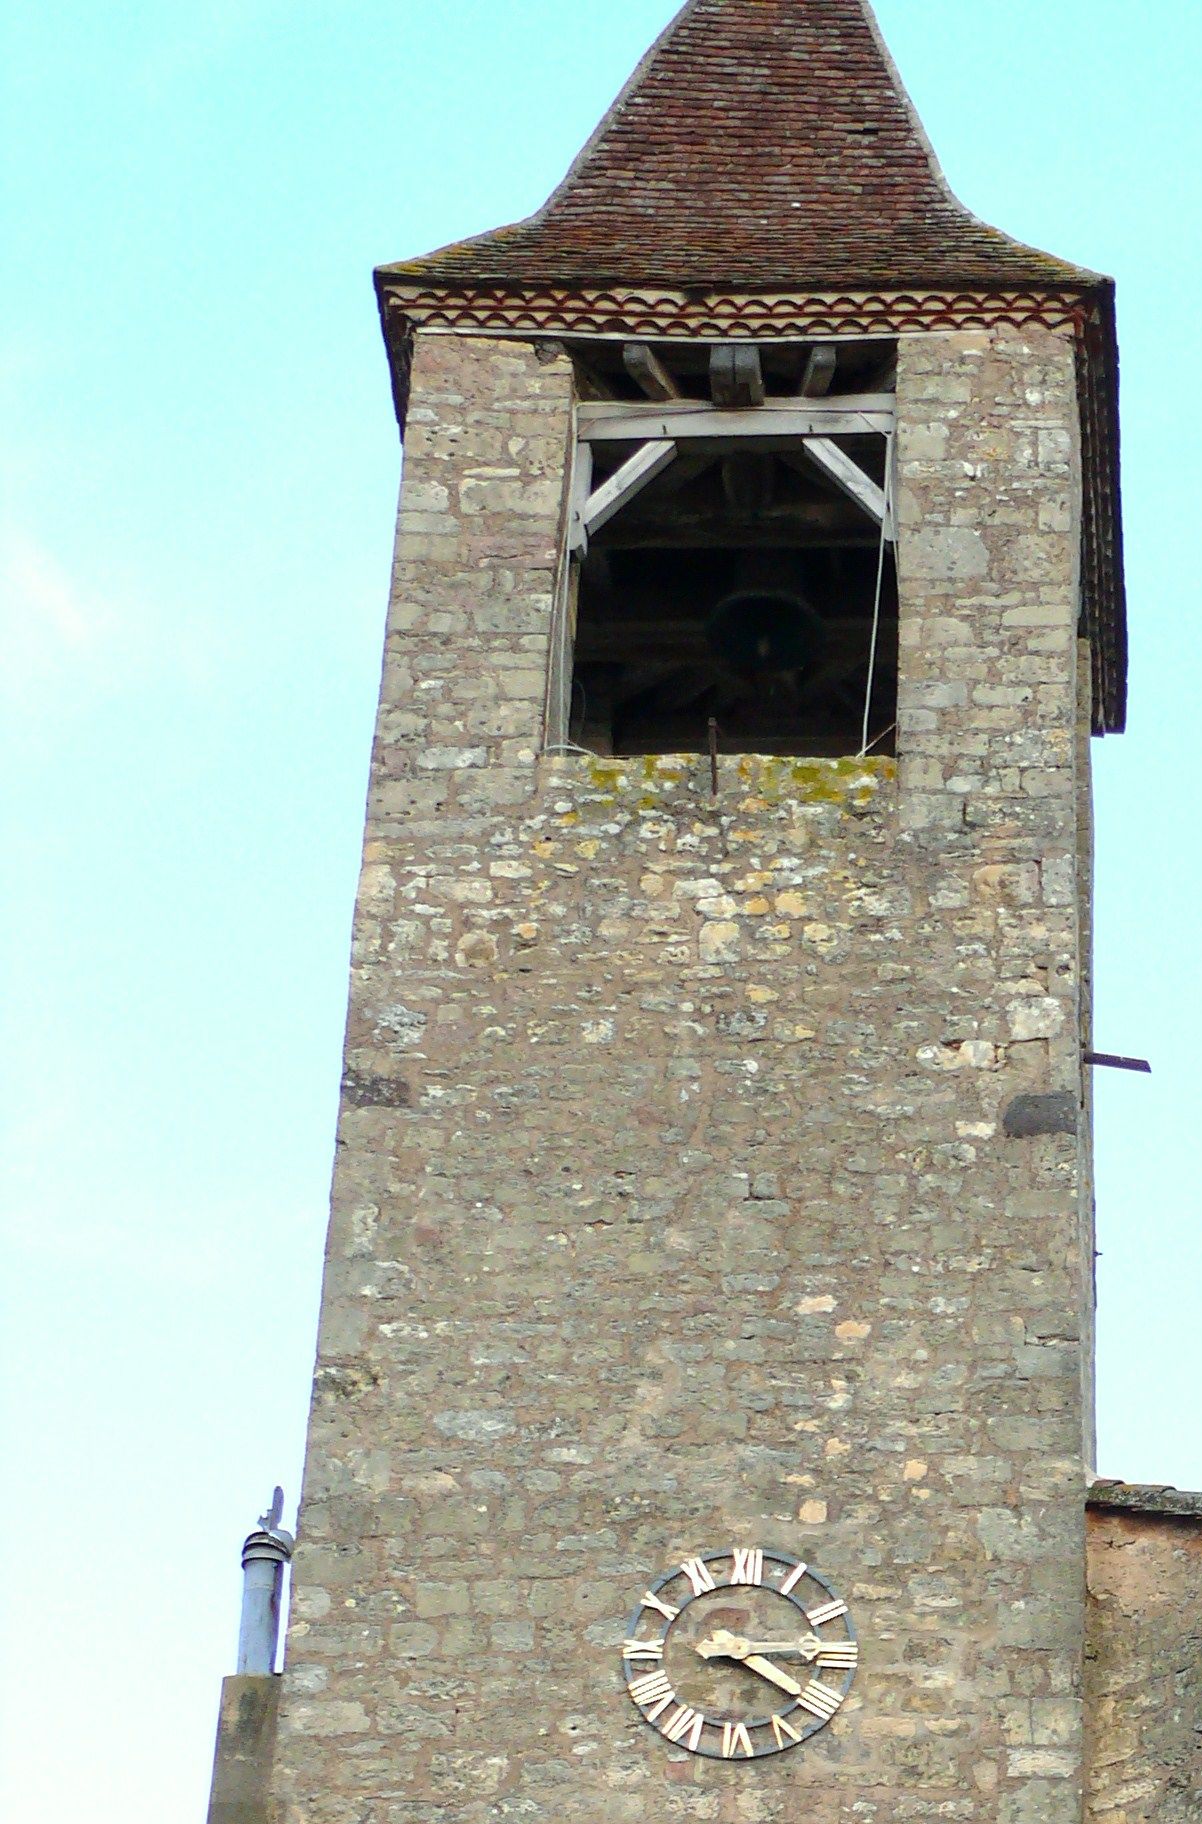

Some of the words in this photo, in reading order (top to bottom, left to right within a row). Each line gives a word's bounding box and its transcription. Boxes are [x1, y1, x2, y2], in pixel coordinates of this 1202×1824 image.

[680, 1557, 716, 1597] XI
[730, 1548, 763, 1585] XII
[780, 1562, 807, 1596] I
[640, 1591, 681, 1621] X
[806, 1599, 849, 1627] II
[623, 1639, 665, 1659] IX
[628, 1670, 676, 1722] VIII
[662, 1704, 704, 1751] VII
[723, 1722, 753, 1758] VI
[772, 1714, 801, 1750] V
